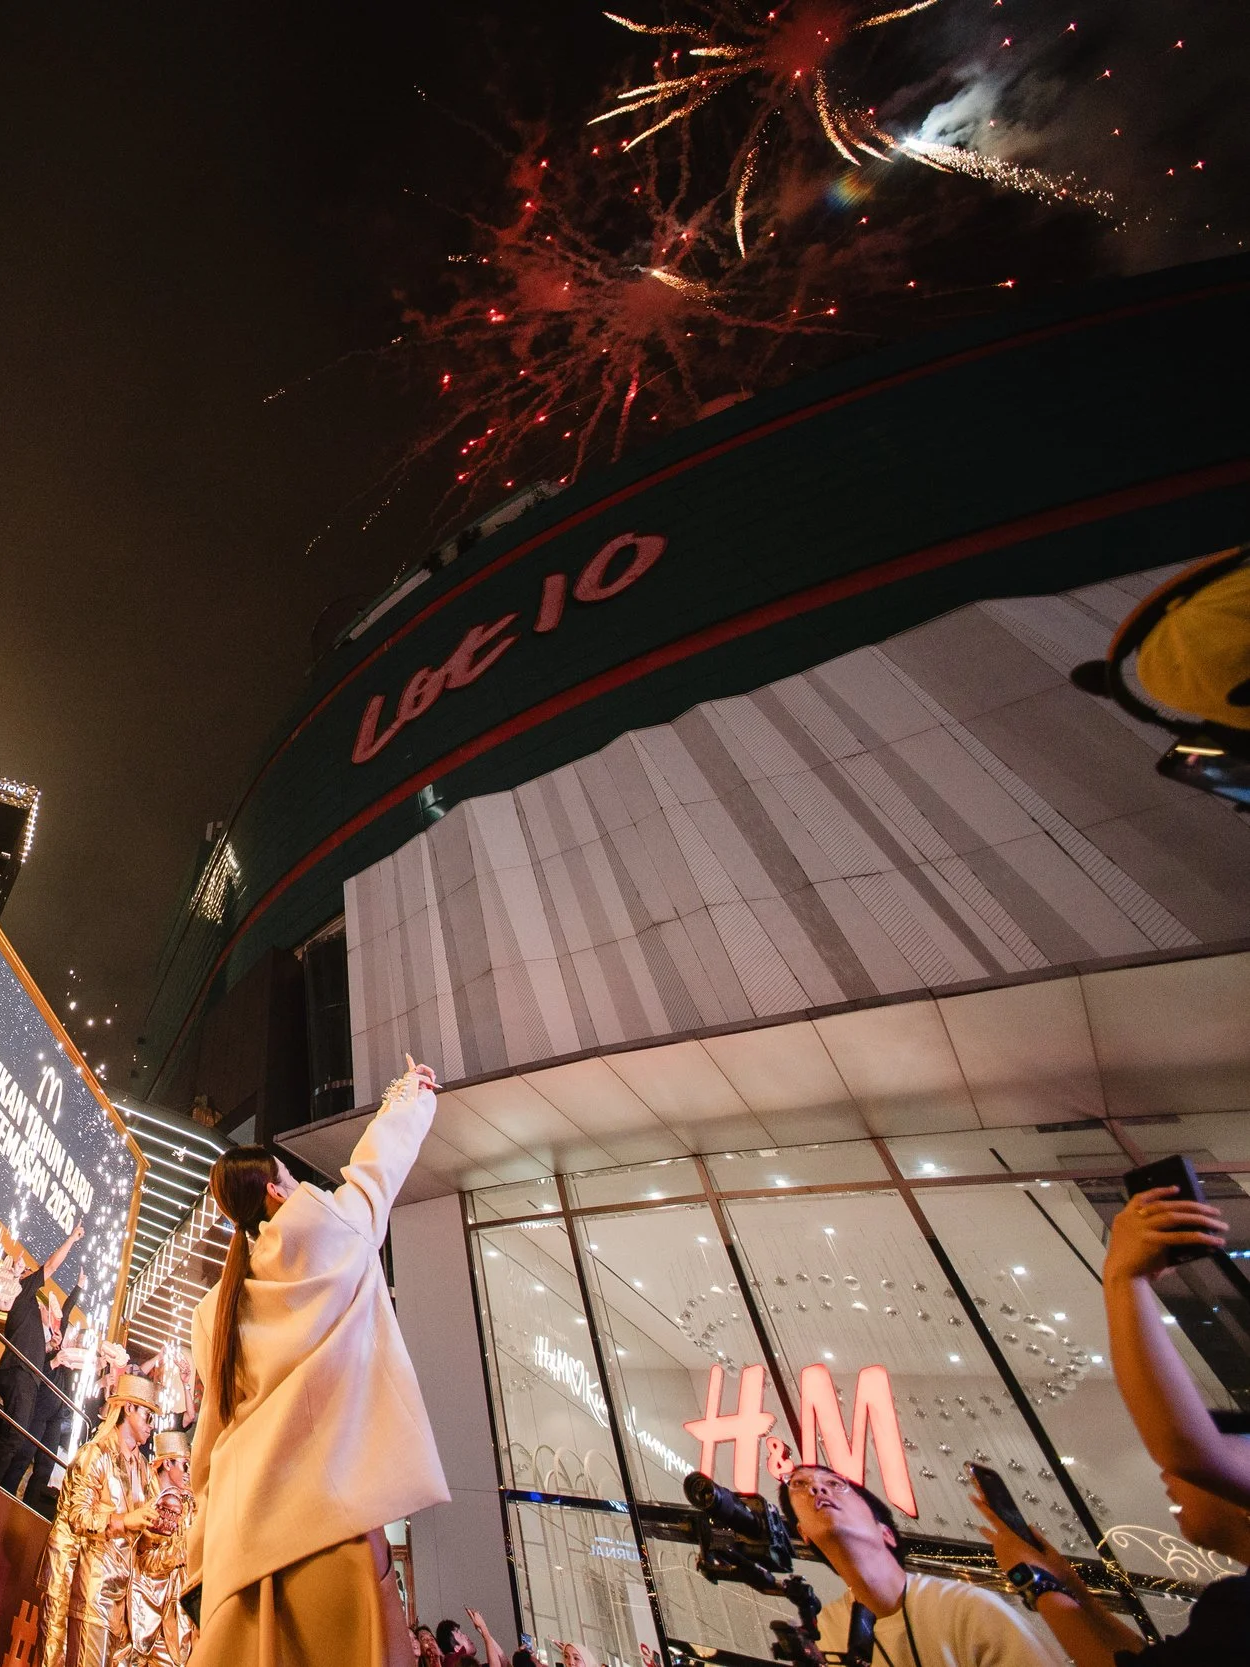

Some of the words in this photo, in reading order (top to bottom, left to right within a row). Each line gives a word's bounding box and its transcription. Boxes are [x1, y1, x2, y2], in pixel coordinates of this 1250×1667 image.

[350, 611, 522, 765] Lot
[532, 530, 669, 634] 10
[24, 1102, 68, 1178] TAHUN
[63, 1157, 95, 1214] BARU
[45, 1181, 77, 1236] 2026
[682, 1362, 919, 1519] H&M
